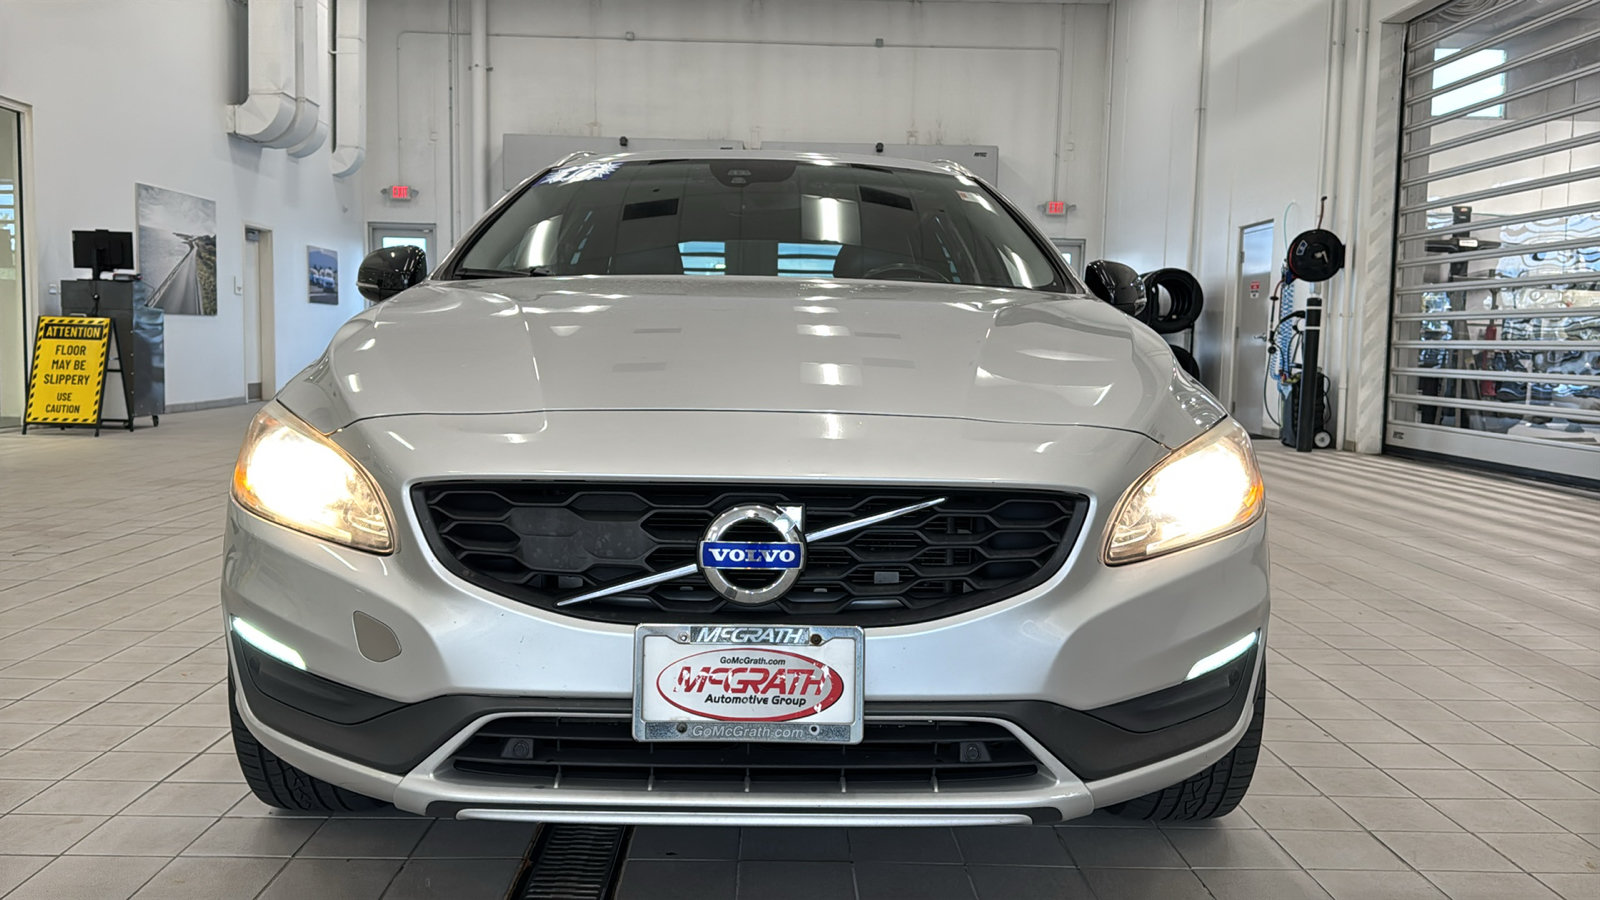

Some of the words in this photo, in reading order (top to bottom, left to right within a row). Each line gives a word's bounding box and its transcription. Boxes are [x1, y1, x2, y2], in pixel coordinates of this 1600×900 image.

[46, 325, 101, 338] ATTENTION
[55, 345, 87, 356] FLOOR
[51, 359, 72, 370] MAY
[74, 360, 87, 371] BE
[43, 373, 91, 386] SLIPPERY
[56, 392, 73, 402] USE
[45, 403, 81, 414] CAUTION
[708, 548, 796, 563] VOLVO
[719, 656, 786, 666] GoMcGrath.com
[704, 693, 769, 705] Automotive
[771, 694, 807, 708] Group
[692, 725, 804, 739] GoMcGrath.com
